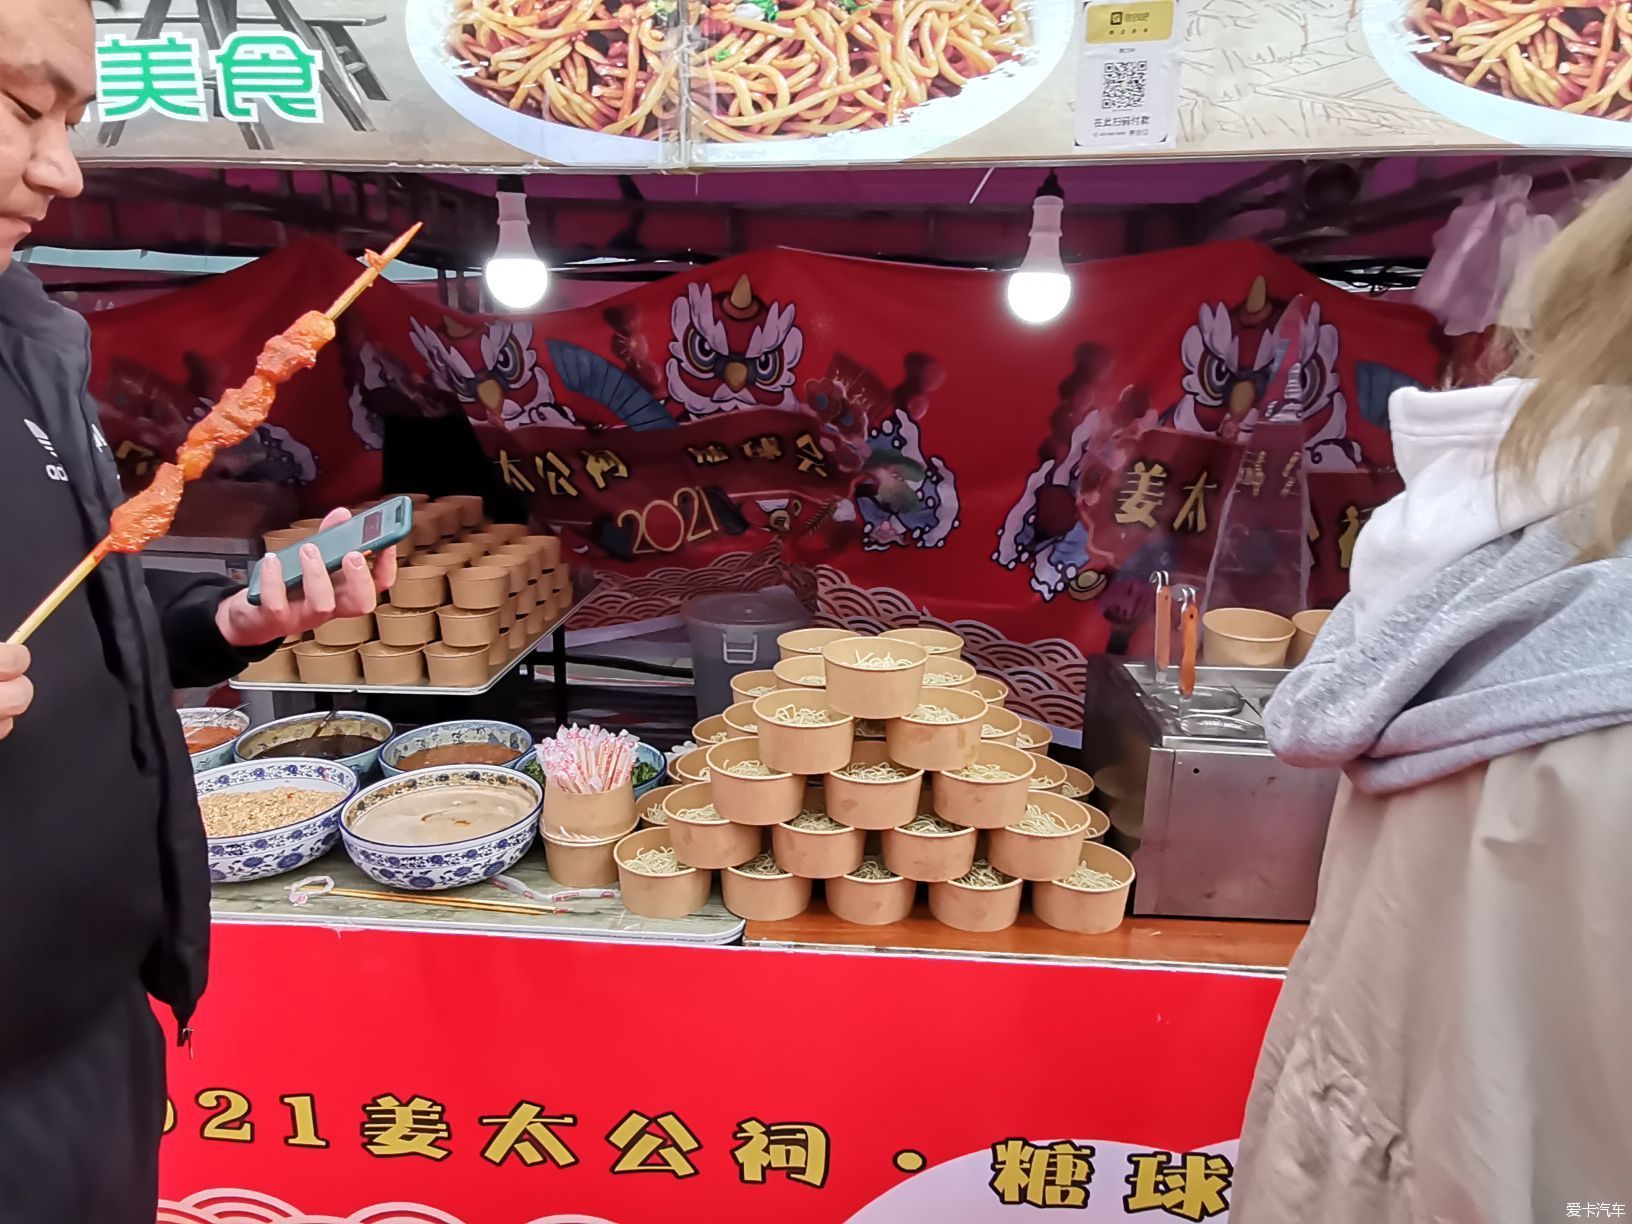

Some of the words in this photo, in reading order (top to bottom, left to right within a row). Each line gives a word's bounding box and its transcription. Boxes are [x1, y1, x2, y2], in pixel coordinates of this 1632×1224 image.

[96, 32, 322, 122] 美食
[616, 486, 719, 555] 2021
[163, 1087, 1234, 1221] 21姜太公祠·糖球
